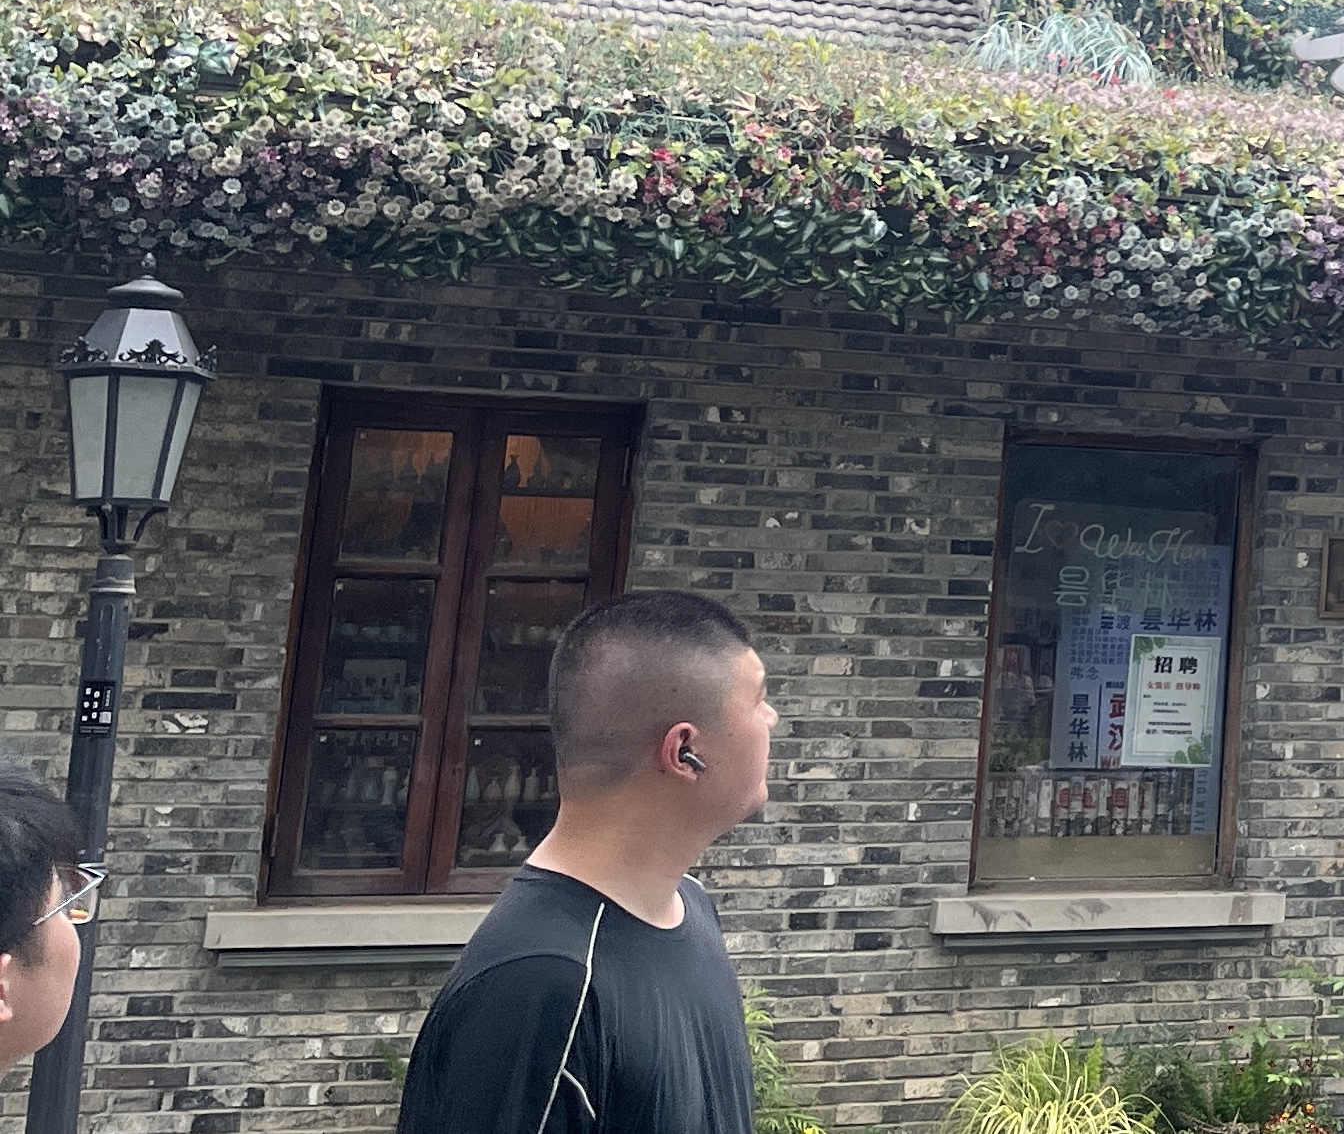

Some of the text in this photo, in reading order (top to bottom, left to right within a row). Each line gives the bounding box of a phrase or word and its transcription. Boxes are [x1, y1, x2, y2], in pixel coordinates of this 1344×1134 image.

[1014, 502, 1056, 554] I
[1140, 607, 1218, 632] 昙华林
[1153, 655, 1199, 675] 招聘
[1068, 693, 1092, 763] 昙华林
